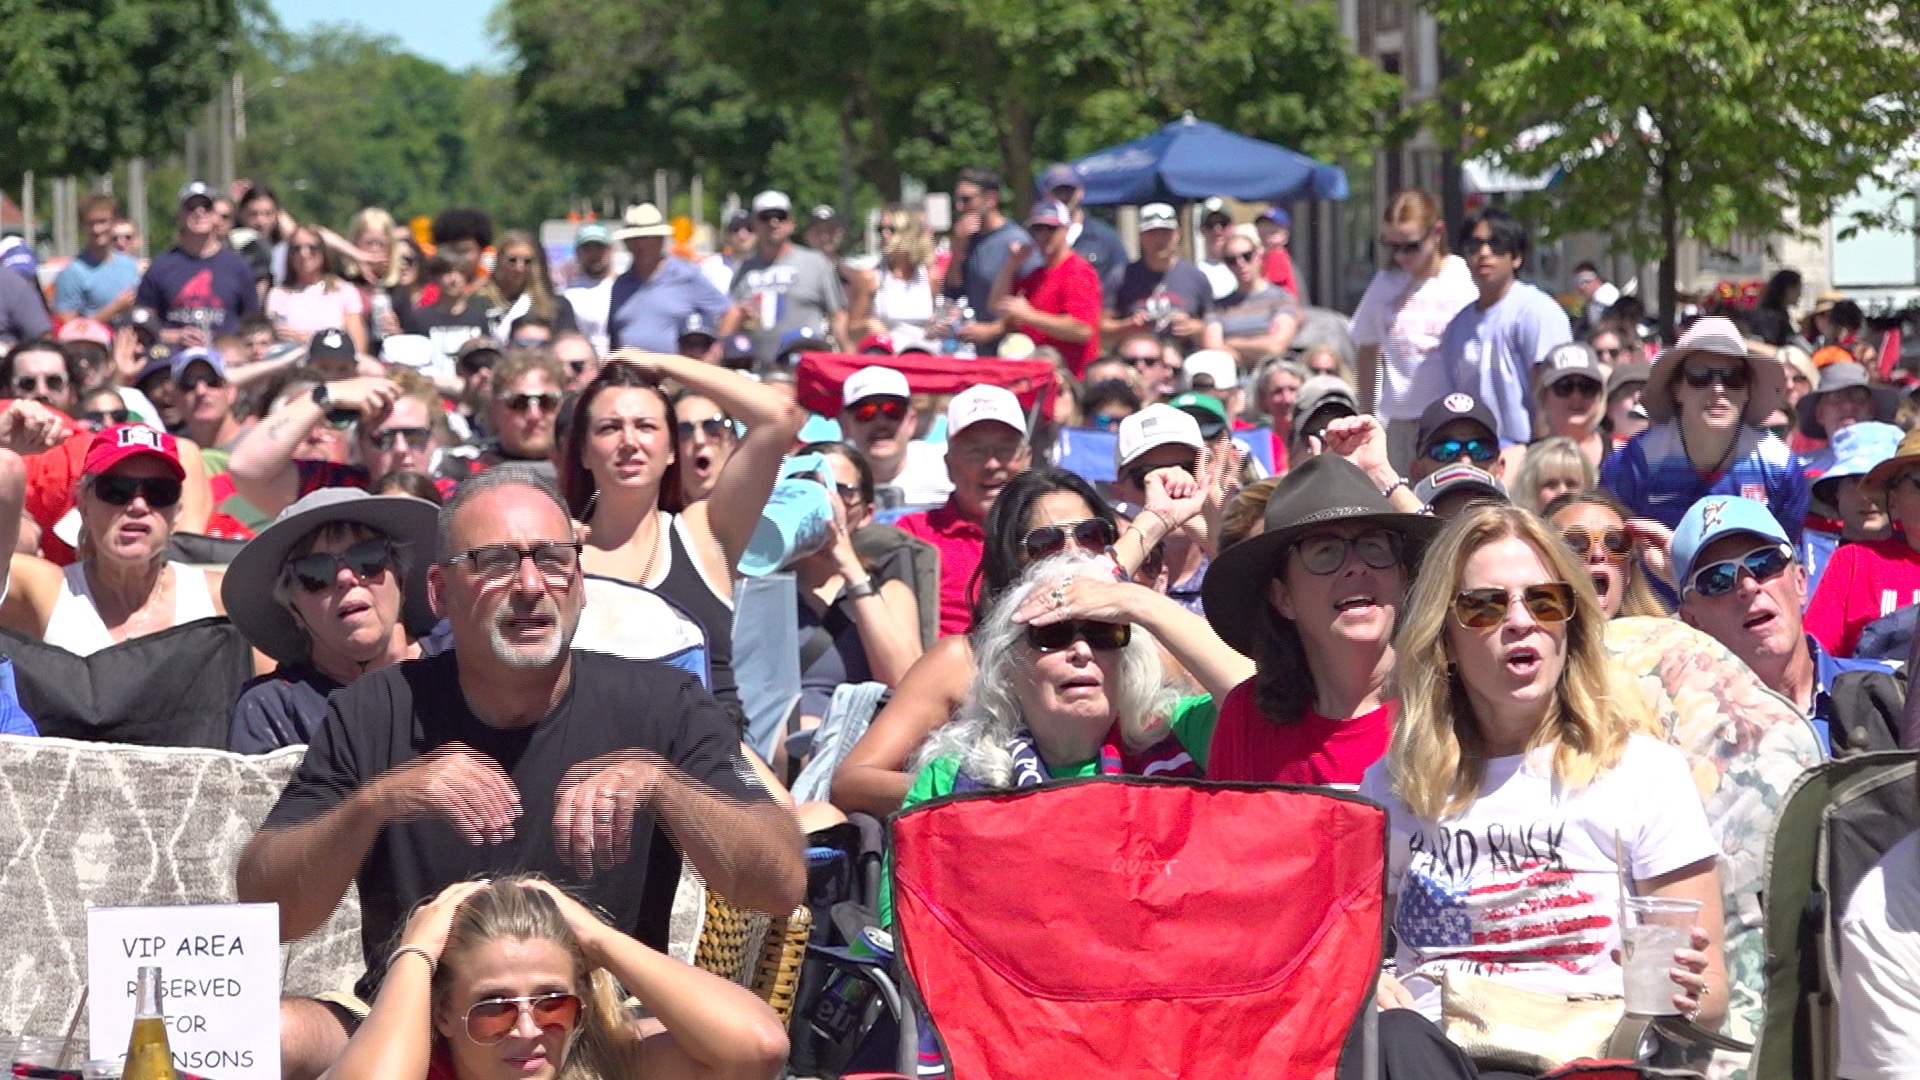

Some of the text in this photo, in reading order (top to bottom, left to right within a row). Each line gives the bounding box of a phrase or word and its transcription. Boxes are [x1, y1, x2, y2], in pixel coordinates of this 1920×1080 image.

[122, 934, 244, 958] VIP AREA
[126, 977, 241, 999] RSERVED
